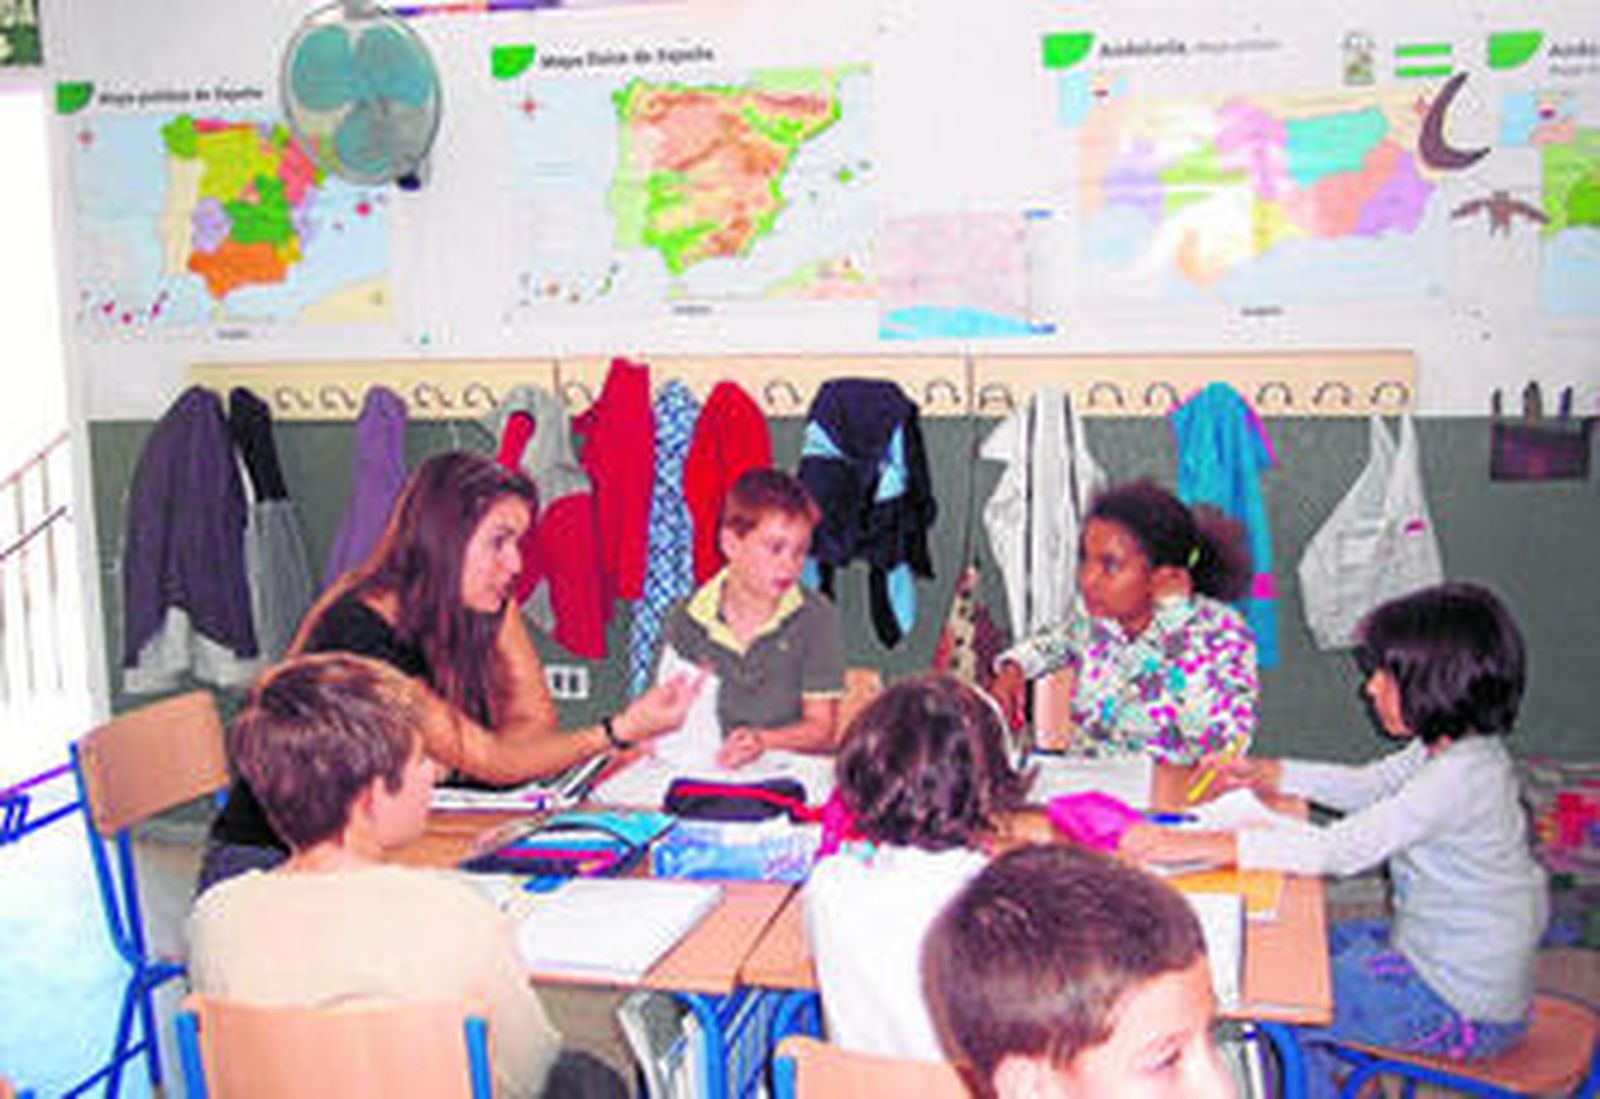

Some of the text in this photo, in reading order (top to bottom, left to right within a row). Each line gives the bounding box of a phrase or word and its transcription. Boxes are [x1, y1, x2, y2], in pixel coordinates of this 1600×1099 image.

[541, 52, 583, 70] Mapa
[634, 48, 651, 64] de
[195, 88, 211, 103] de
